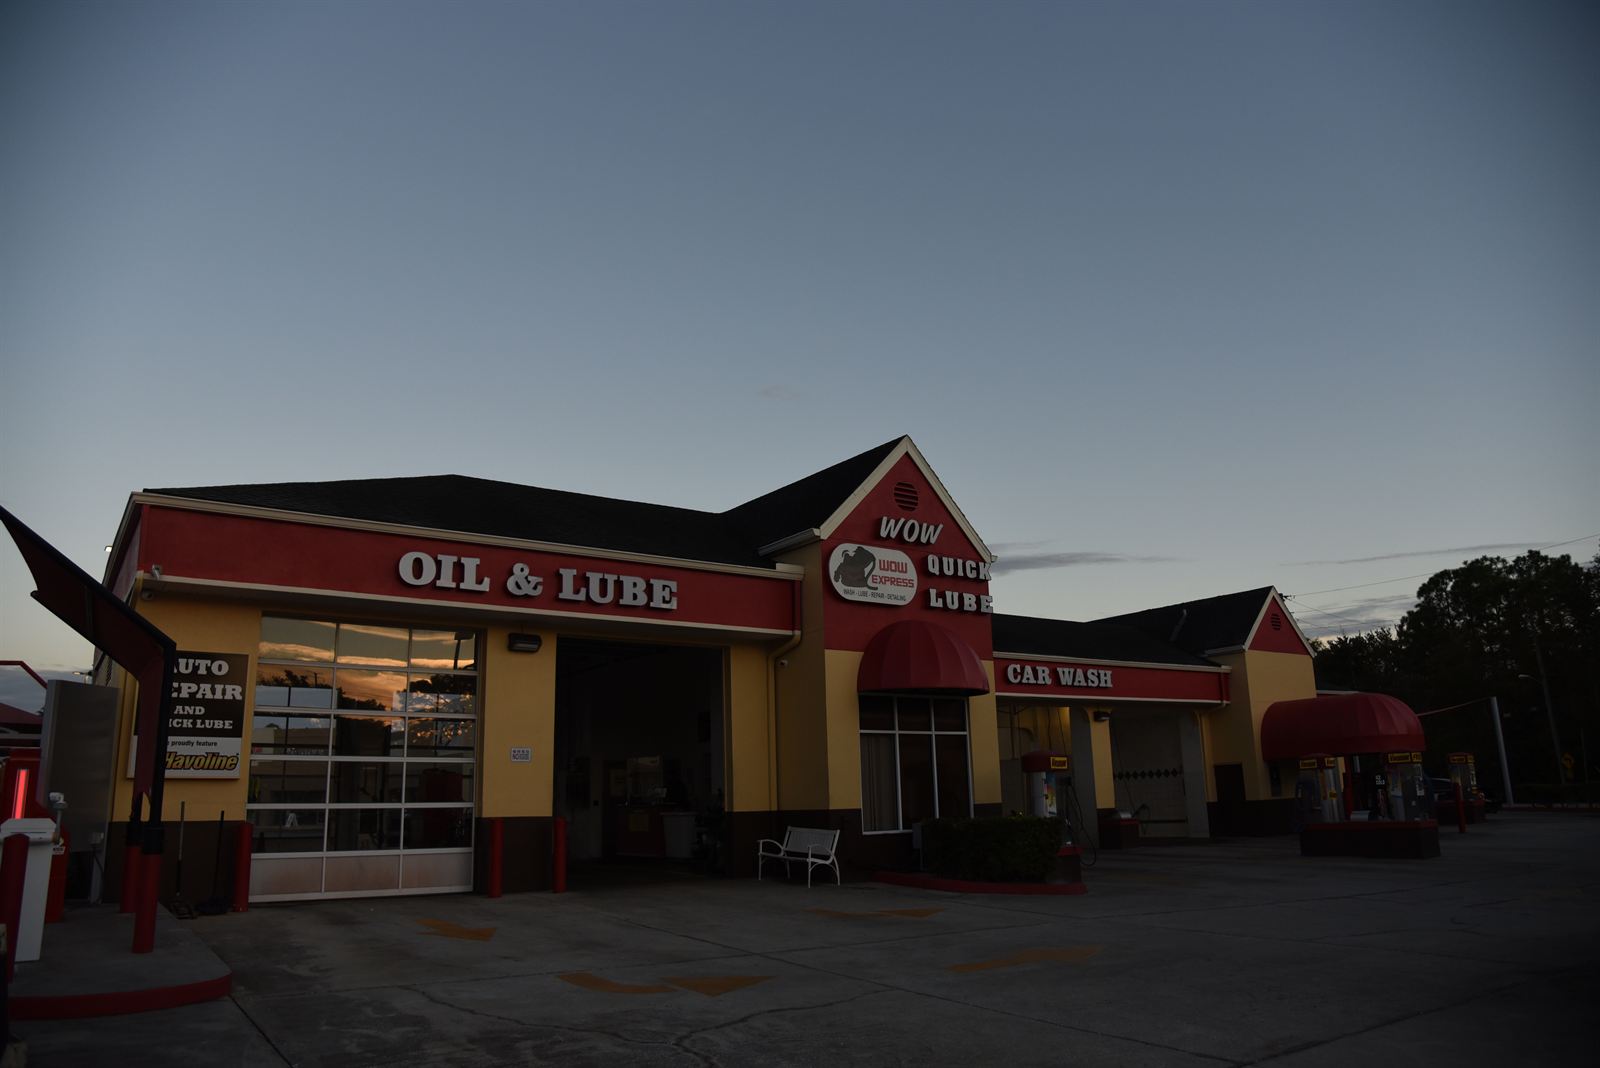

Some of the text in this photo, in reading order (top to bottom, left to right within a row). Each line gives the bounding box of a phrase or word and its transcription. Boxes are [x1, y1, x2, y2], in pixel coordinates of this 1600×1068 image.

[879, 516, 944, 545] WOW
[879, 559, 907, 574] WOW
[927, 554, 992, 581] QUICK
[398, 551, 678, 610] OIL & LUBE
[872, 574, 915, 588] EXPRESS
[929, 588, 994, 614] LUBE
[174, 658, 229, 676] UTO
[1007, 664, 1113, 688] CAR WASH
[174, 705, 206, 716] AND
[196, 719, 233, 729] LUBE
[171, 740, 194, 748] proudly
[164, 752, 238, 770] Havoline
